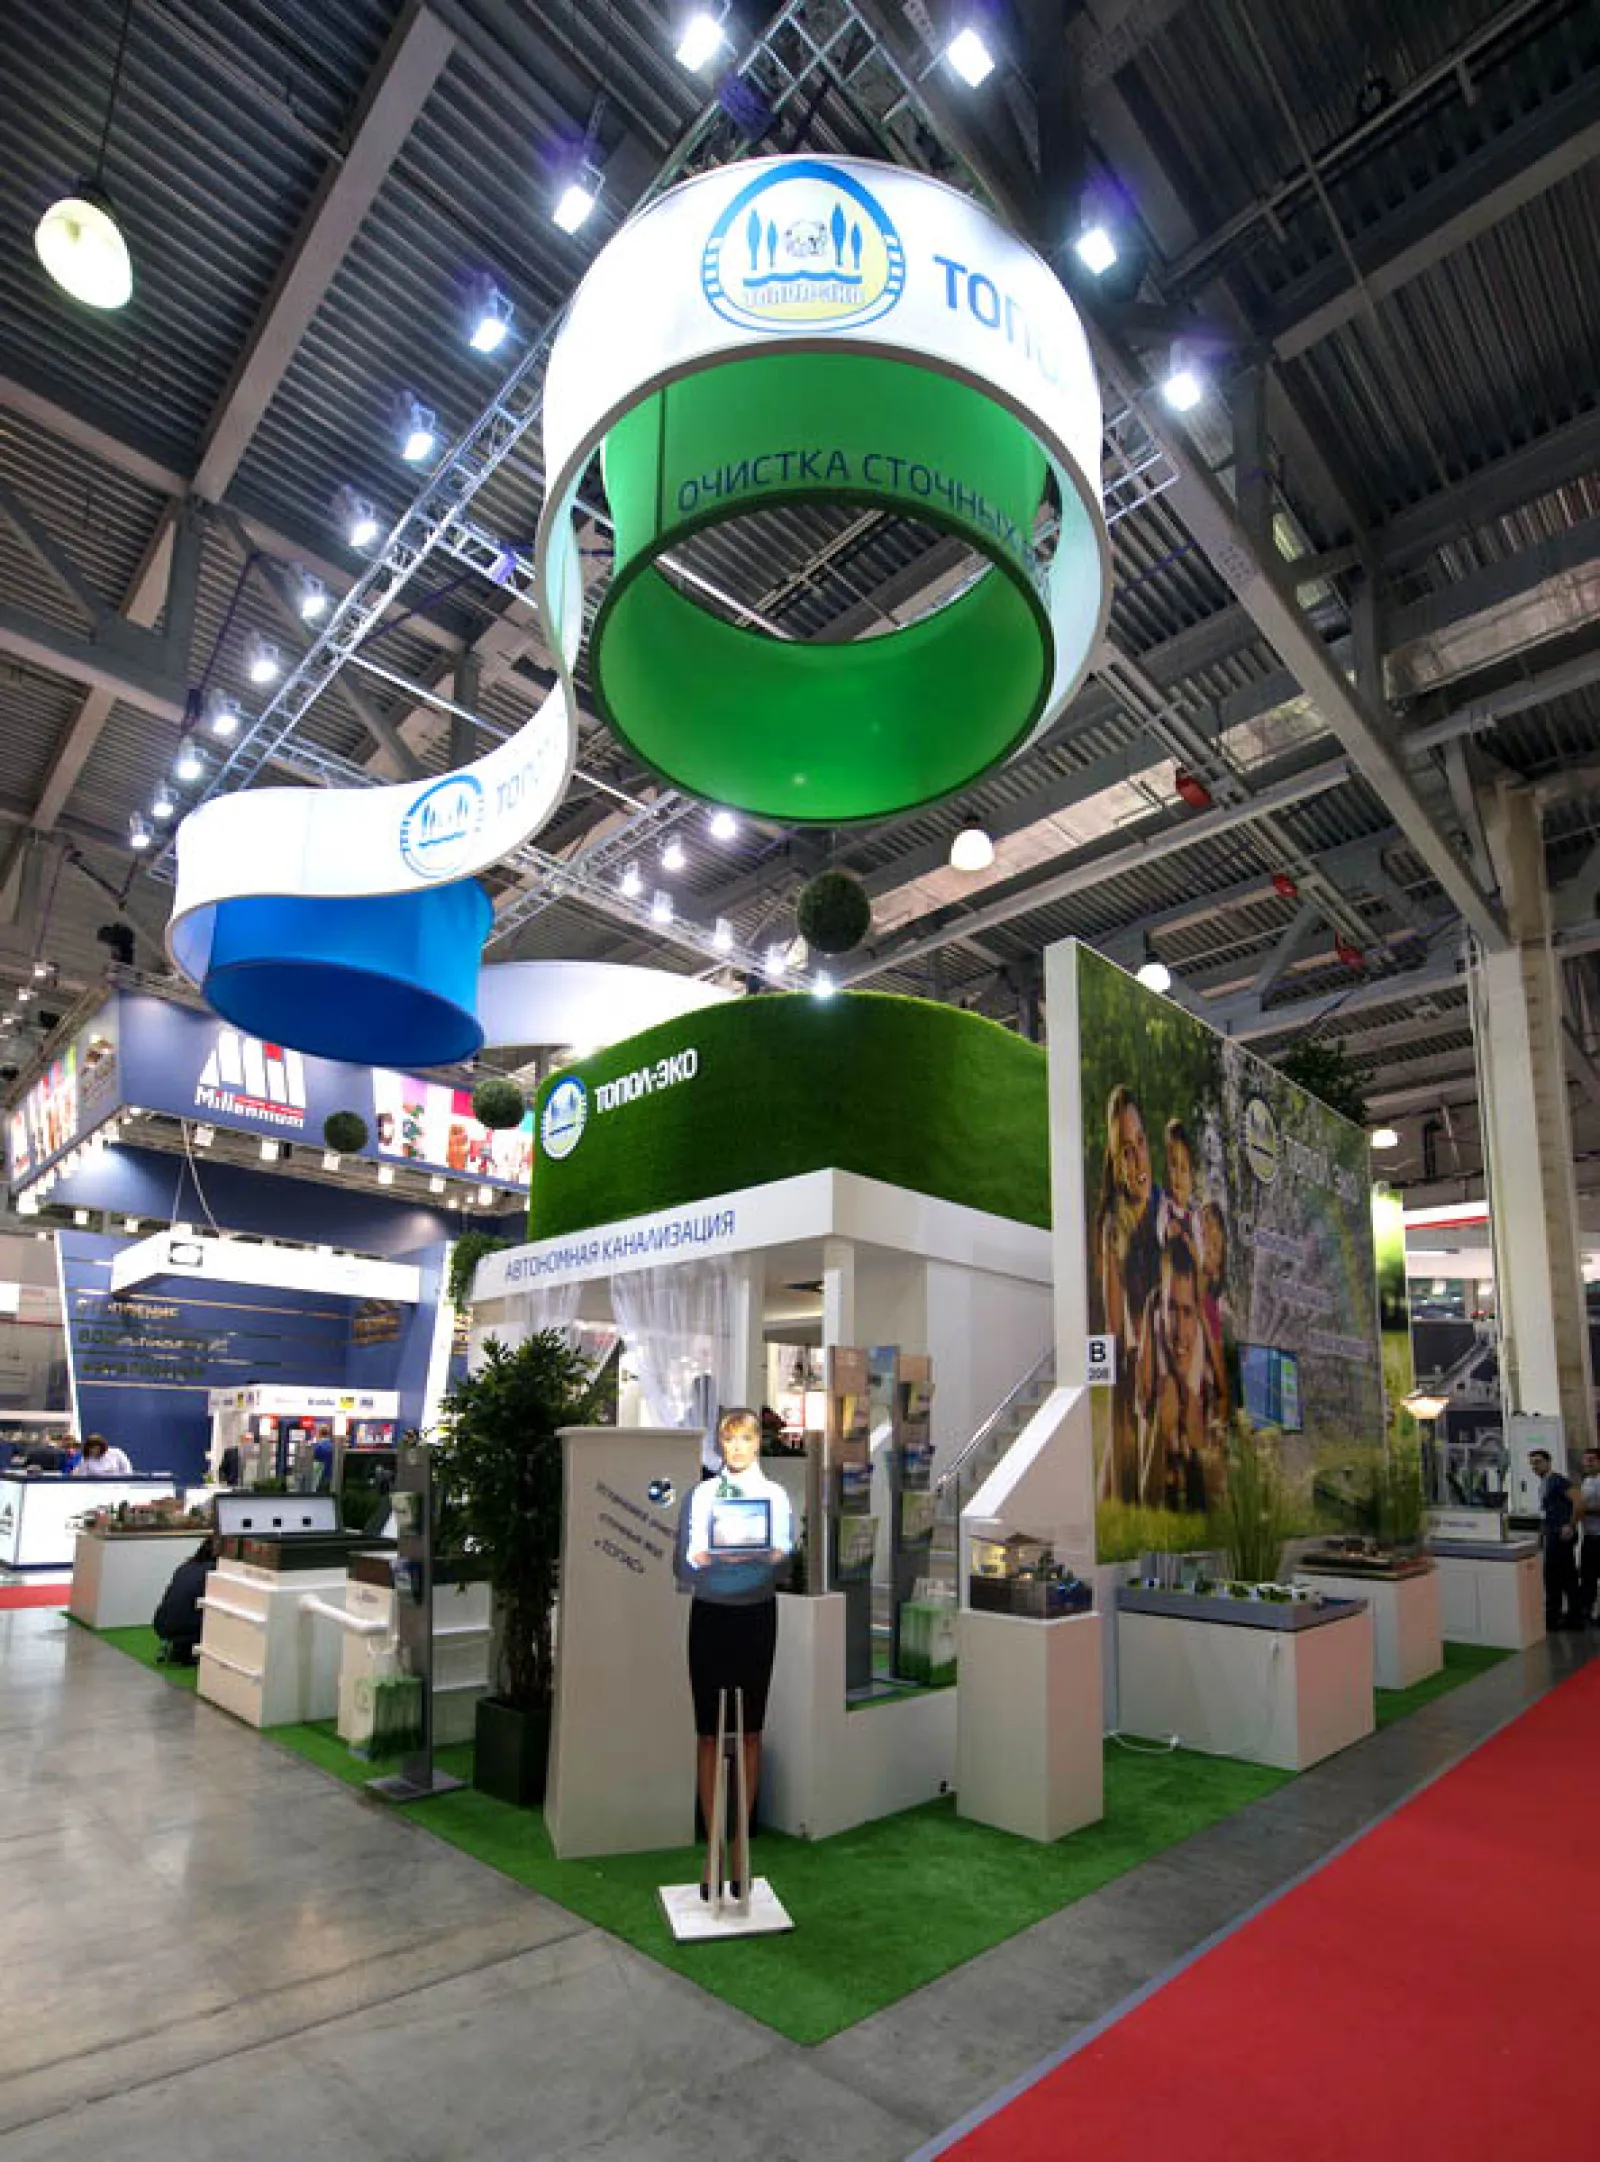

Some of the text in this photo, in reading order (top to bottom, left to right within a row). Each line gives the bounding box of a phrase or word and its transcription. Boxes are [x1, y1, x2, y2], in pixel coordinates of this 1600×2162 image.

[677, 449, 1018, 549] ОЧИСТКА СТОЧНЫХ
[594, 1048, 700, 1115] ТОПОЛ-ЭКО
[504, 1208, 737, 1282] АВТОНОМНАЯ КАНАЛИЗАЦИЯ
[1089, 1340, 1107, 1363] B
